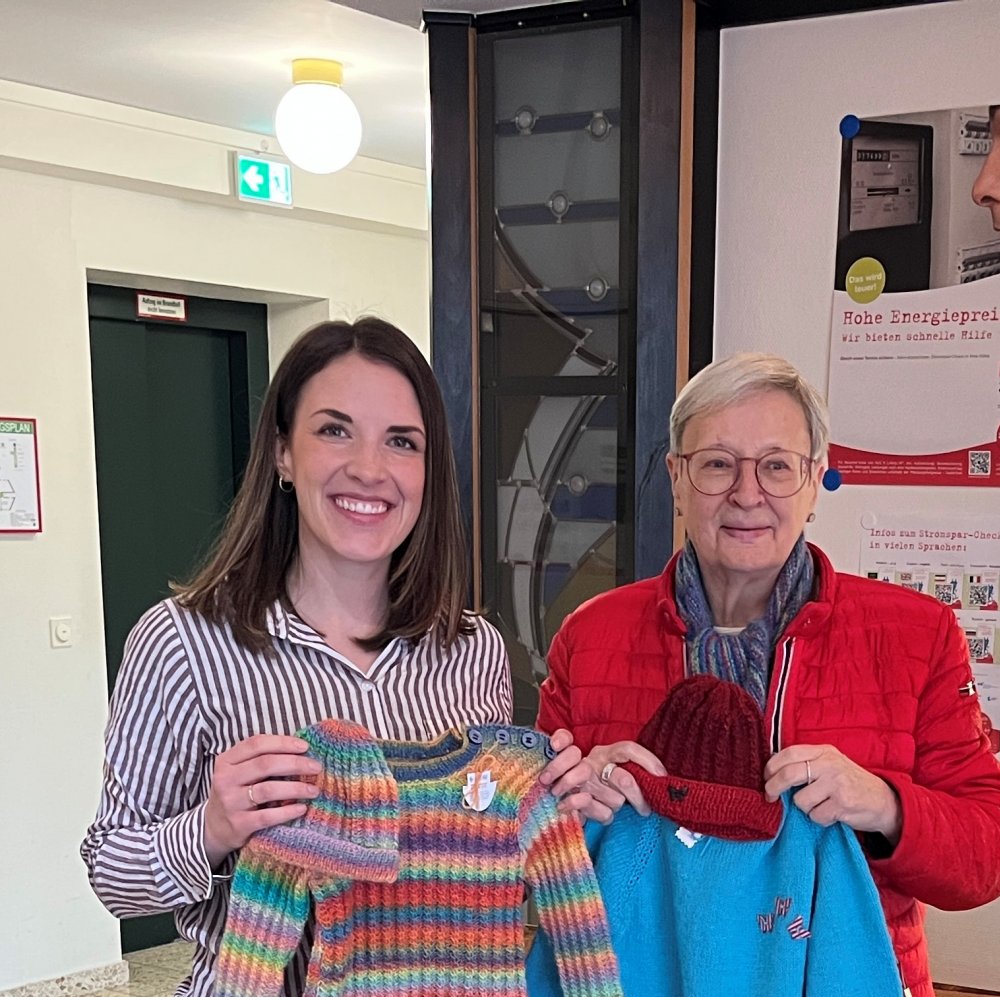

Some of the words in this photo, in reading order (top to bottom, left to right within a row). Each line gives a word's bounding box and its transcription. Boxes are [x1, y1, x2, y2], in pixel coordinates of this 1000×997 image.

[843, 311, 883, 325] Hohe
[866, 333, 901, 342] bieten
[961, 330, 992, 340] Hilfe
[870, 528, 896, 537] Infos
[869, 541, 881, 549] in
[884, 542, 915, 550] vielen
[918, 543, 967, 552] Sprachen:
